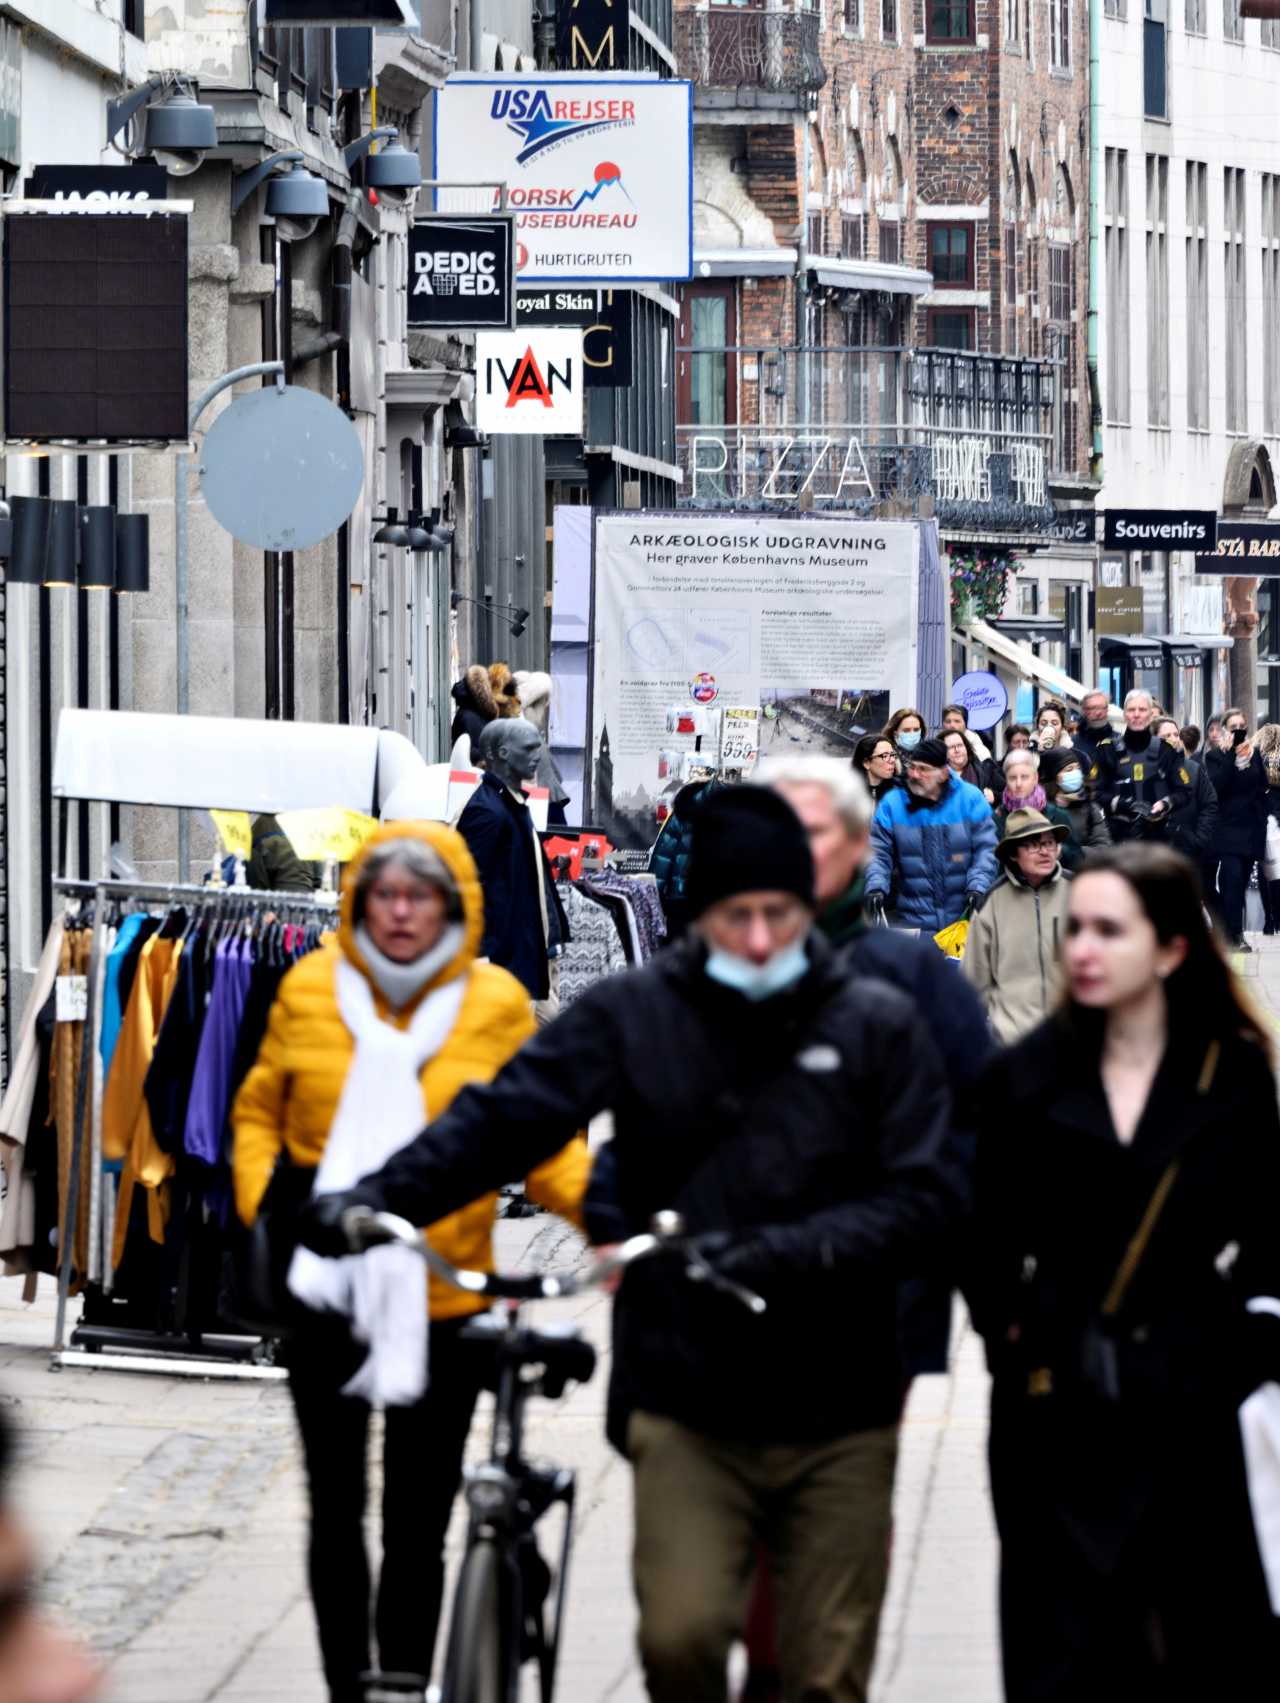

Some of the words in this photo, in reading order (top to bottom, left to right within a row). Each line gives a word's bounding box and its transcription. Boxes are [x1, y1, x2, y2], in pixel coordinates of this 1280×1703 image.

[490, 90, 553, 119] USA
[555, 100, 635, 119] REJSER
[515, 214, 638, 229] JSEBUREAU
[414, 252, 496, 274] DEDIC
[535, 253, 632, 267] HURTIGRUTEN
[516, 294, 550, 312] oyal
[555, 294, 593, 310] Skin
[486, 344, 572, 408] IVAN
[692, 435, 875, 499] PIZZA
[1115, 520, 1206, 539] Souvenirs
[629, 534, 760, 548] ARKÆOLOGISK
[766, 536, 887, 551] UDGRAVNING
[1248, 538, 1280, 557] BAR
[646, 552, 672, 564] Her
[675, 554, 719, 567] graver
[722, 552, 806, 567] Københavns
[809, 555, 869, 567] Museum
